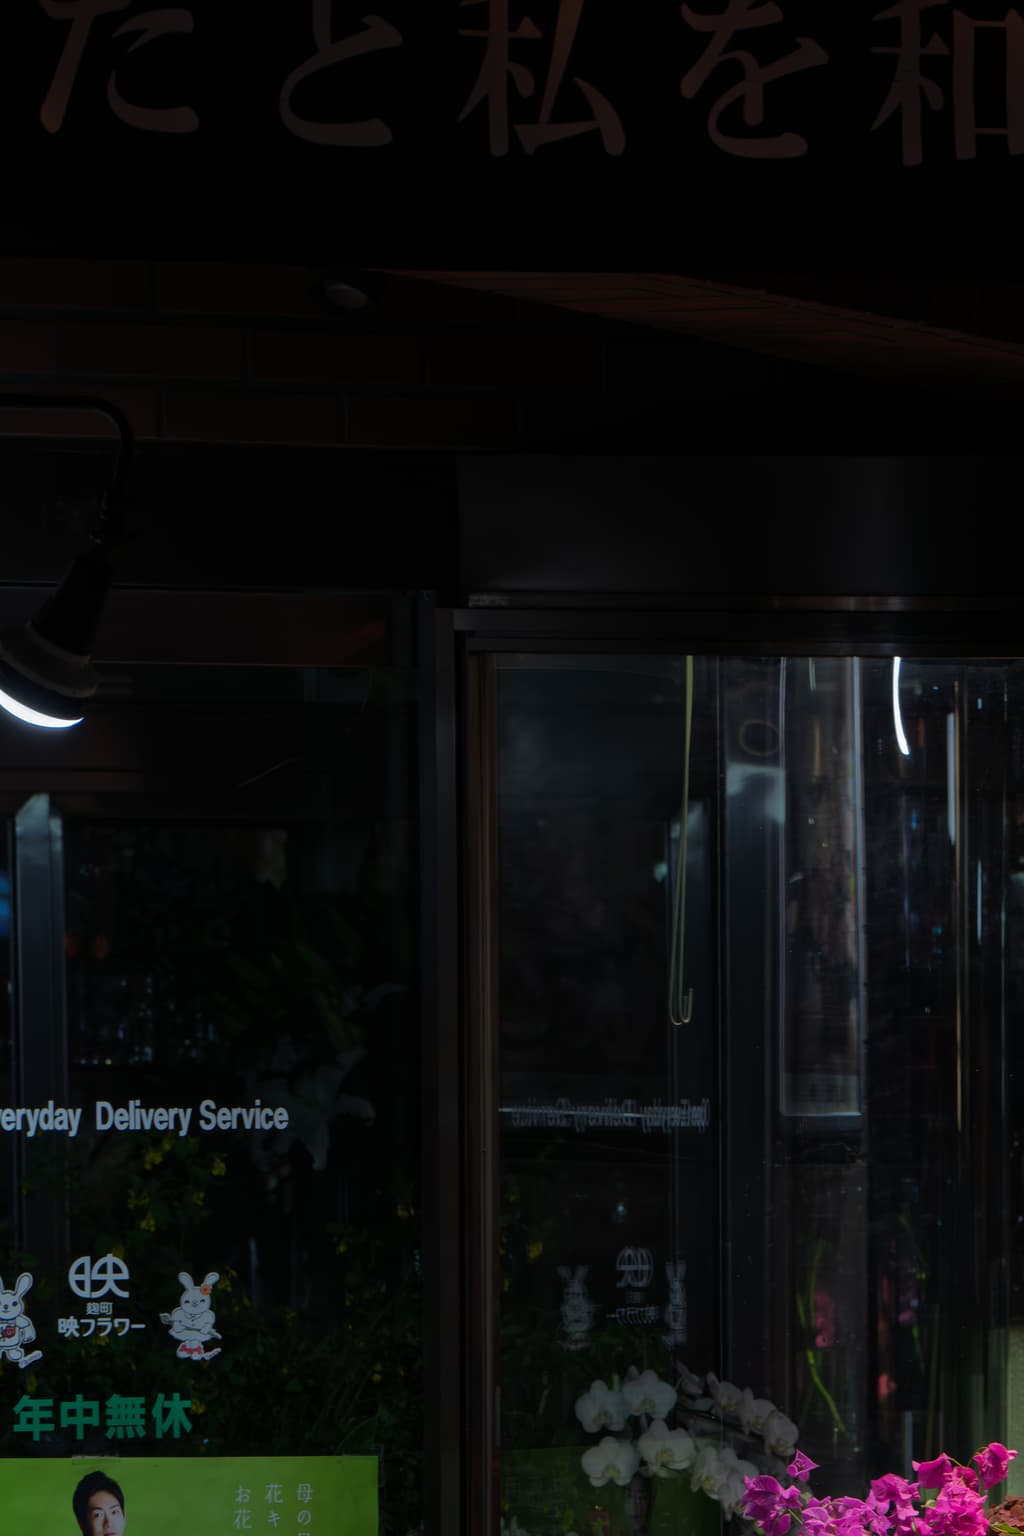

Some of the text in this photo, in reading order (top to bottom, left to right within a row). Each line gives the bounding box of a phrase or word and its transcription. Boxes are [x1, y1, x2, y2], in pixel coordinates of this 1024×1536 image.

[0, 1099, 289, 1137] eryday Delivery Service
[57, 1316, 146, 1338] 映フラワー
[12, 1393, 193, 1441] 年中無休
